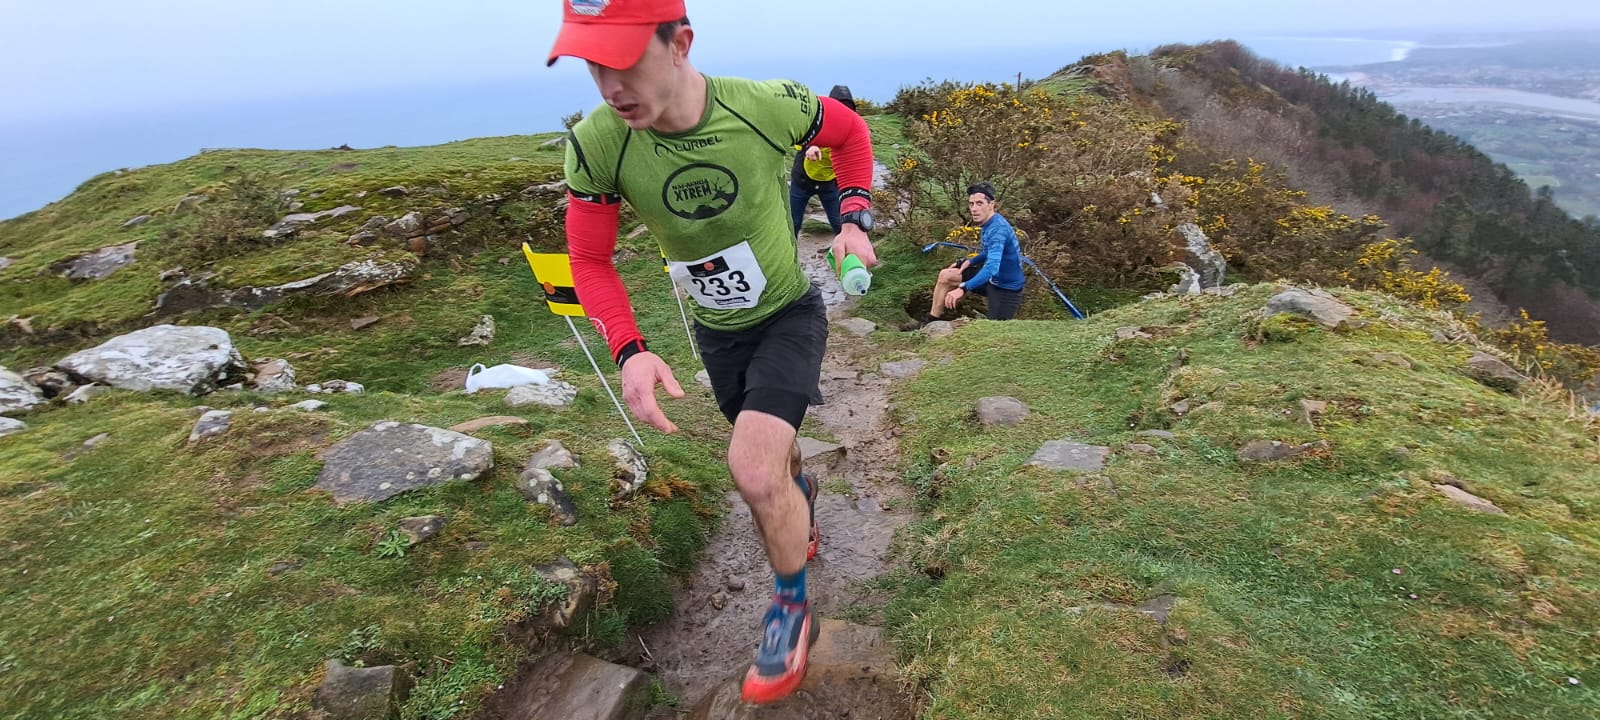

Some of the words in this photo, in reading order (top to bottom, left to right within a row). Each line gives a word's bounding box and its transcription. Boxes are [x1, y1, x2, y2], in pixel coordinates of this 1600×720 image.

[674, 135, 722, 152] LURBEL
[673, 183, 712, 202] XTREM
[691, 270, 751, 297] 233
